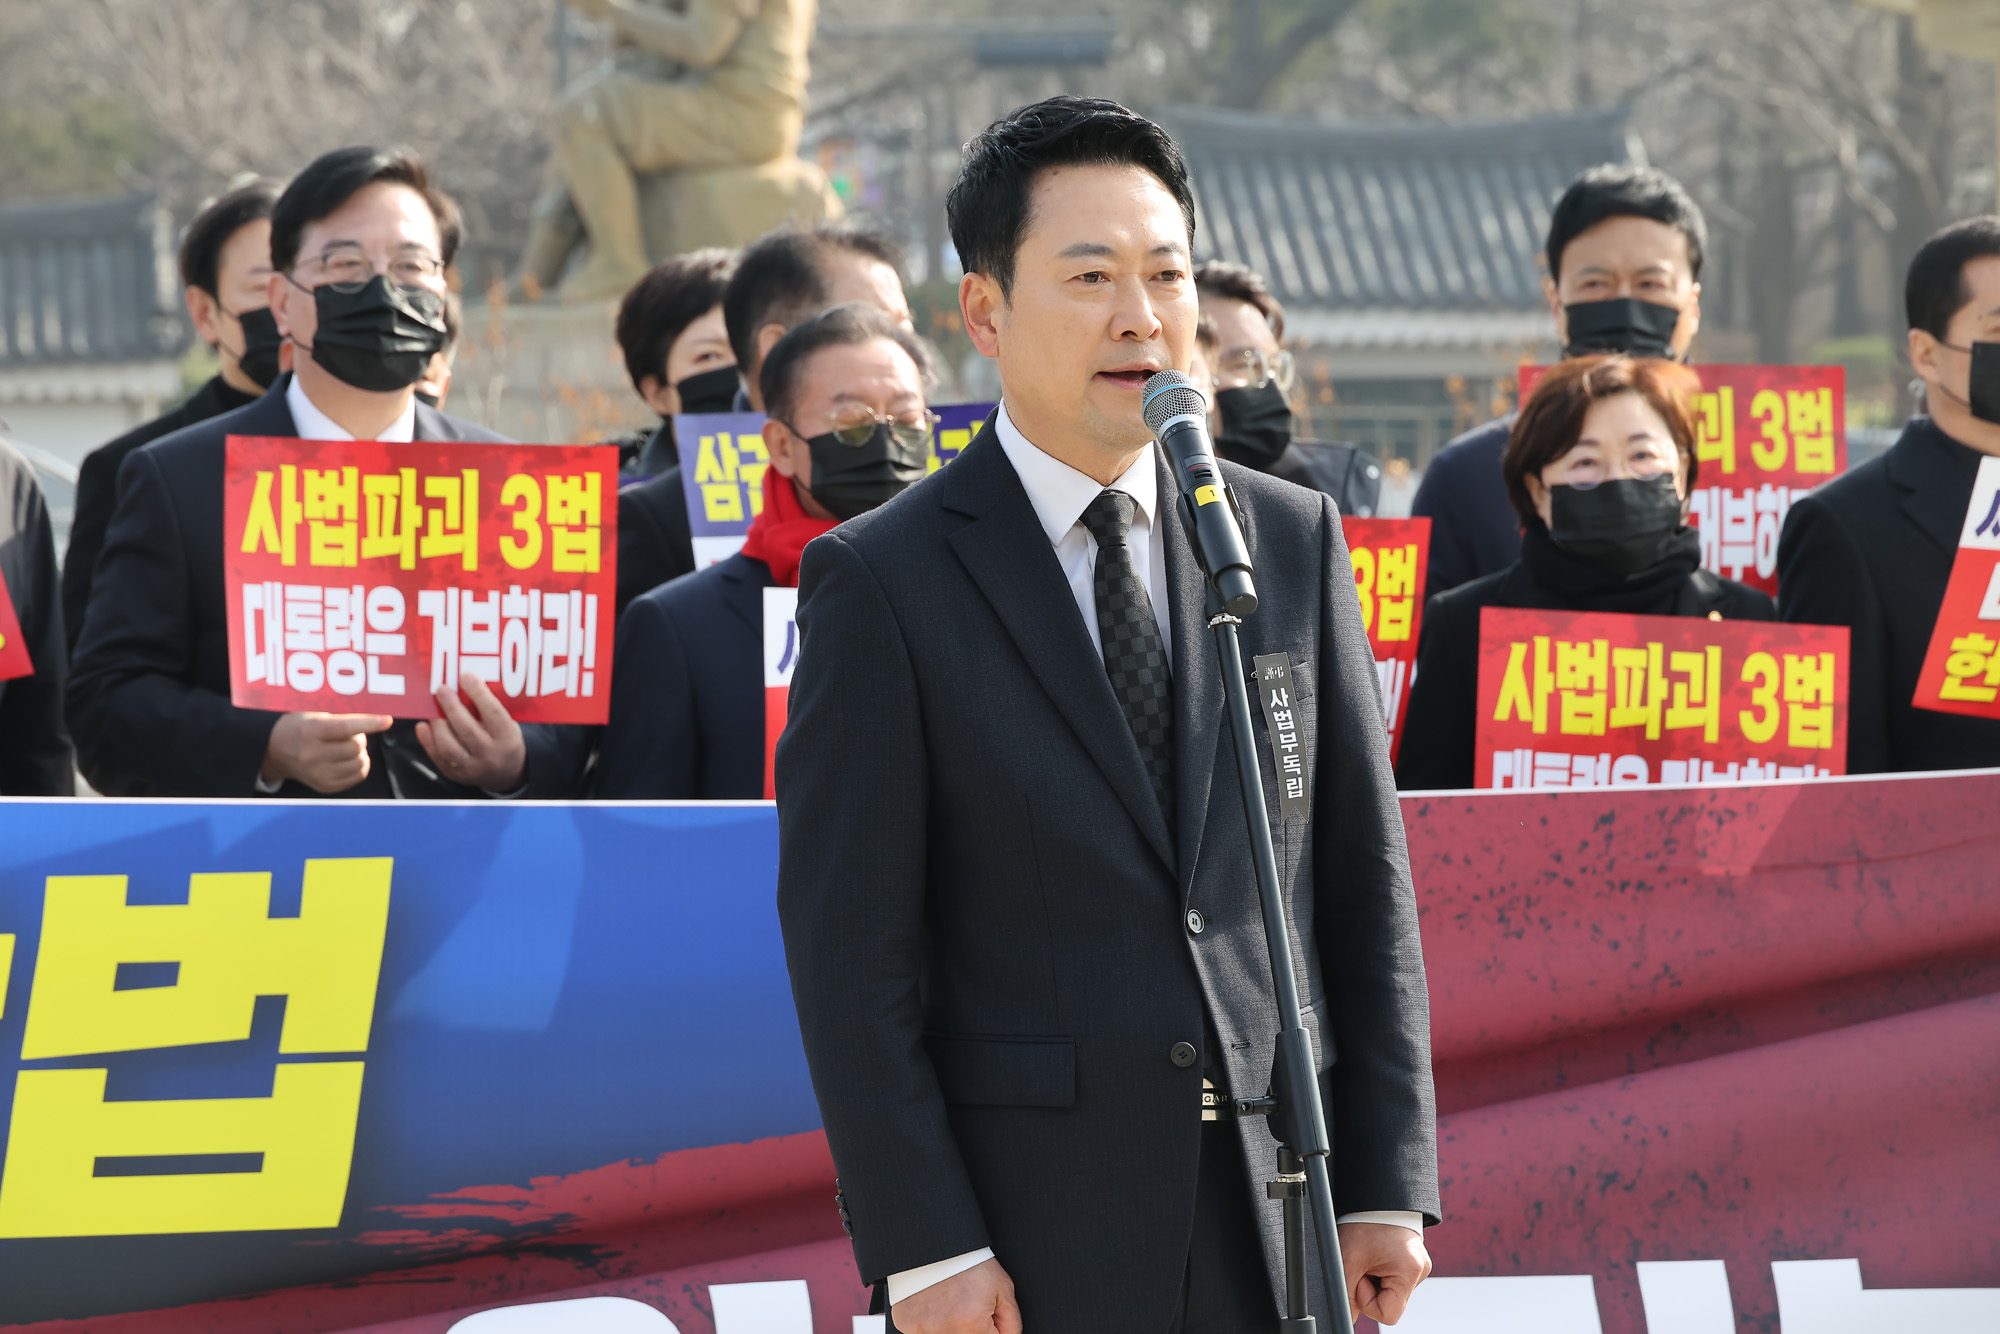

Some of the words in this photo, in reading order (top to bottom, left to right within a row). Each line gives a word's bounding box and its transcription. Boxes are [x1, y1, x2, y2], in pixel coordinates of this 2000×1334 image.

[1750, 388, 1835, 474] 3법
[240, 464, 479, 572] 사법파괴
[499, 472, 601, 573] 3법
[242, 581, 406, 695] 대통령은
[418, 585, 598, 698] 거부하라!
[1493, 636, 1722, 743] 사법파괴
[1739, 651, 1835, 749] 3법
[1270, 687, 1303, 799] 사법부독립
